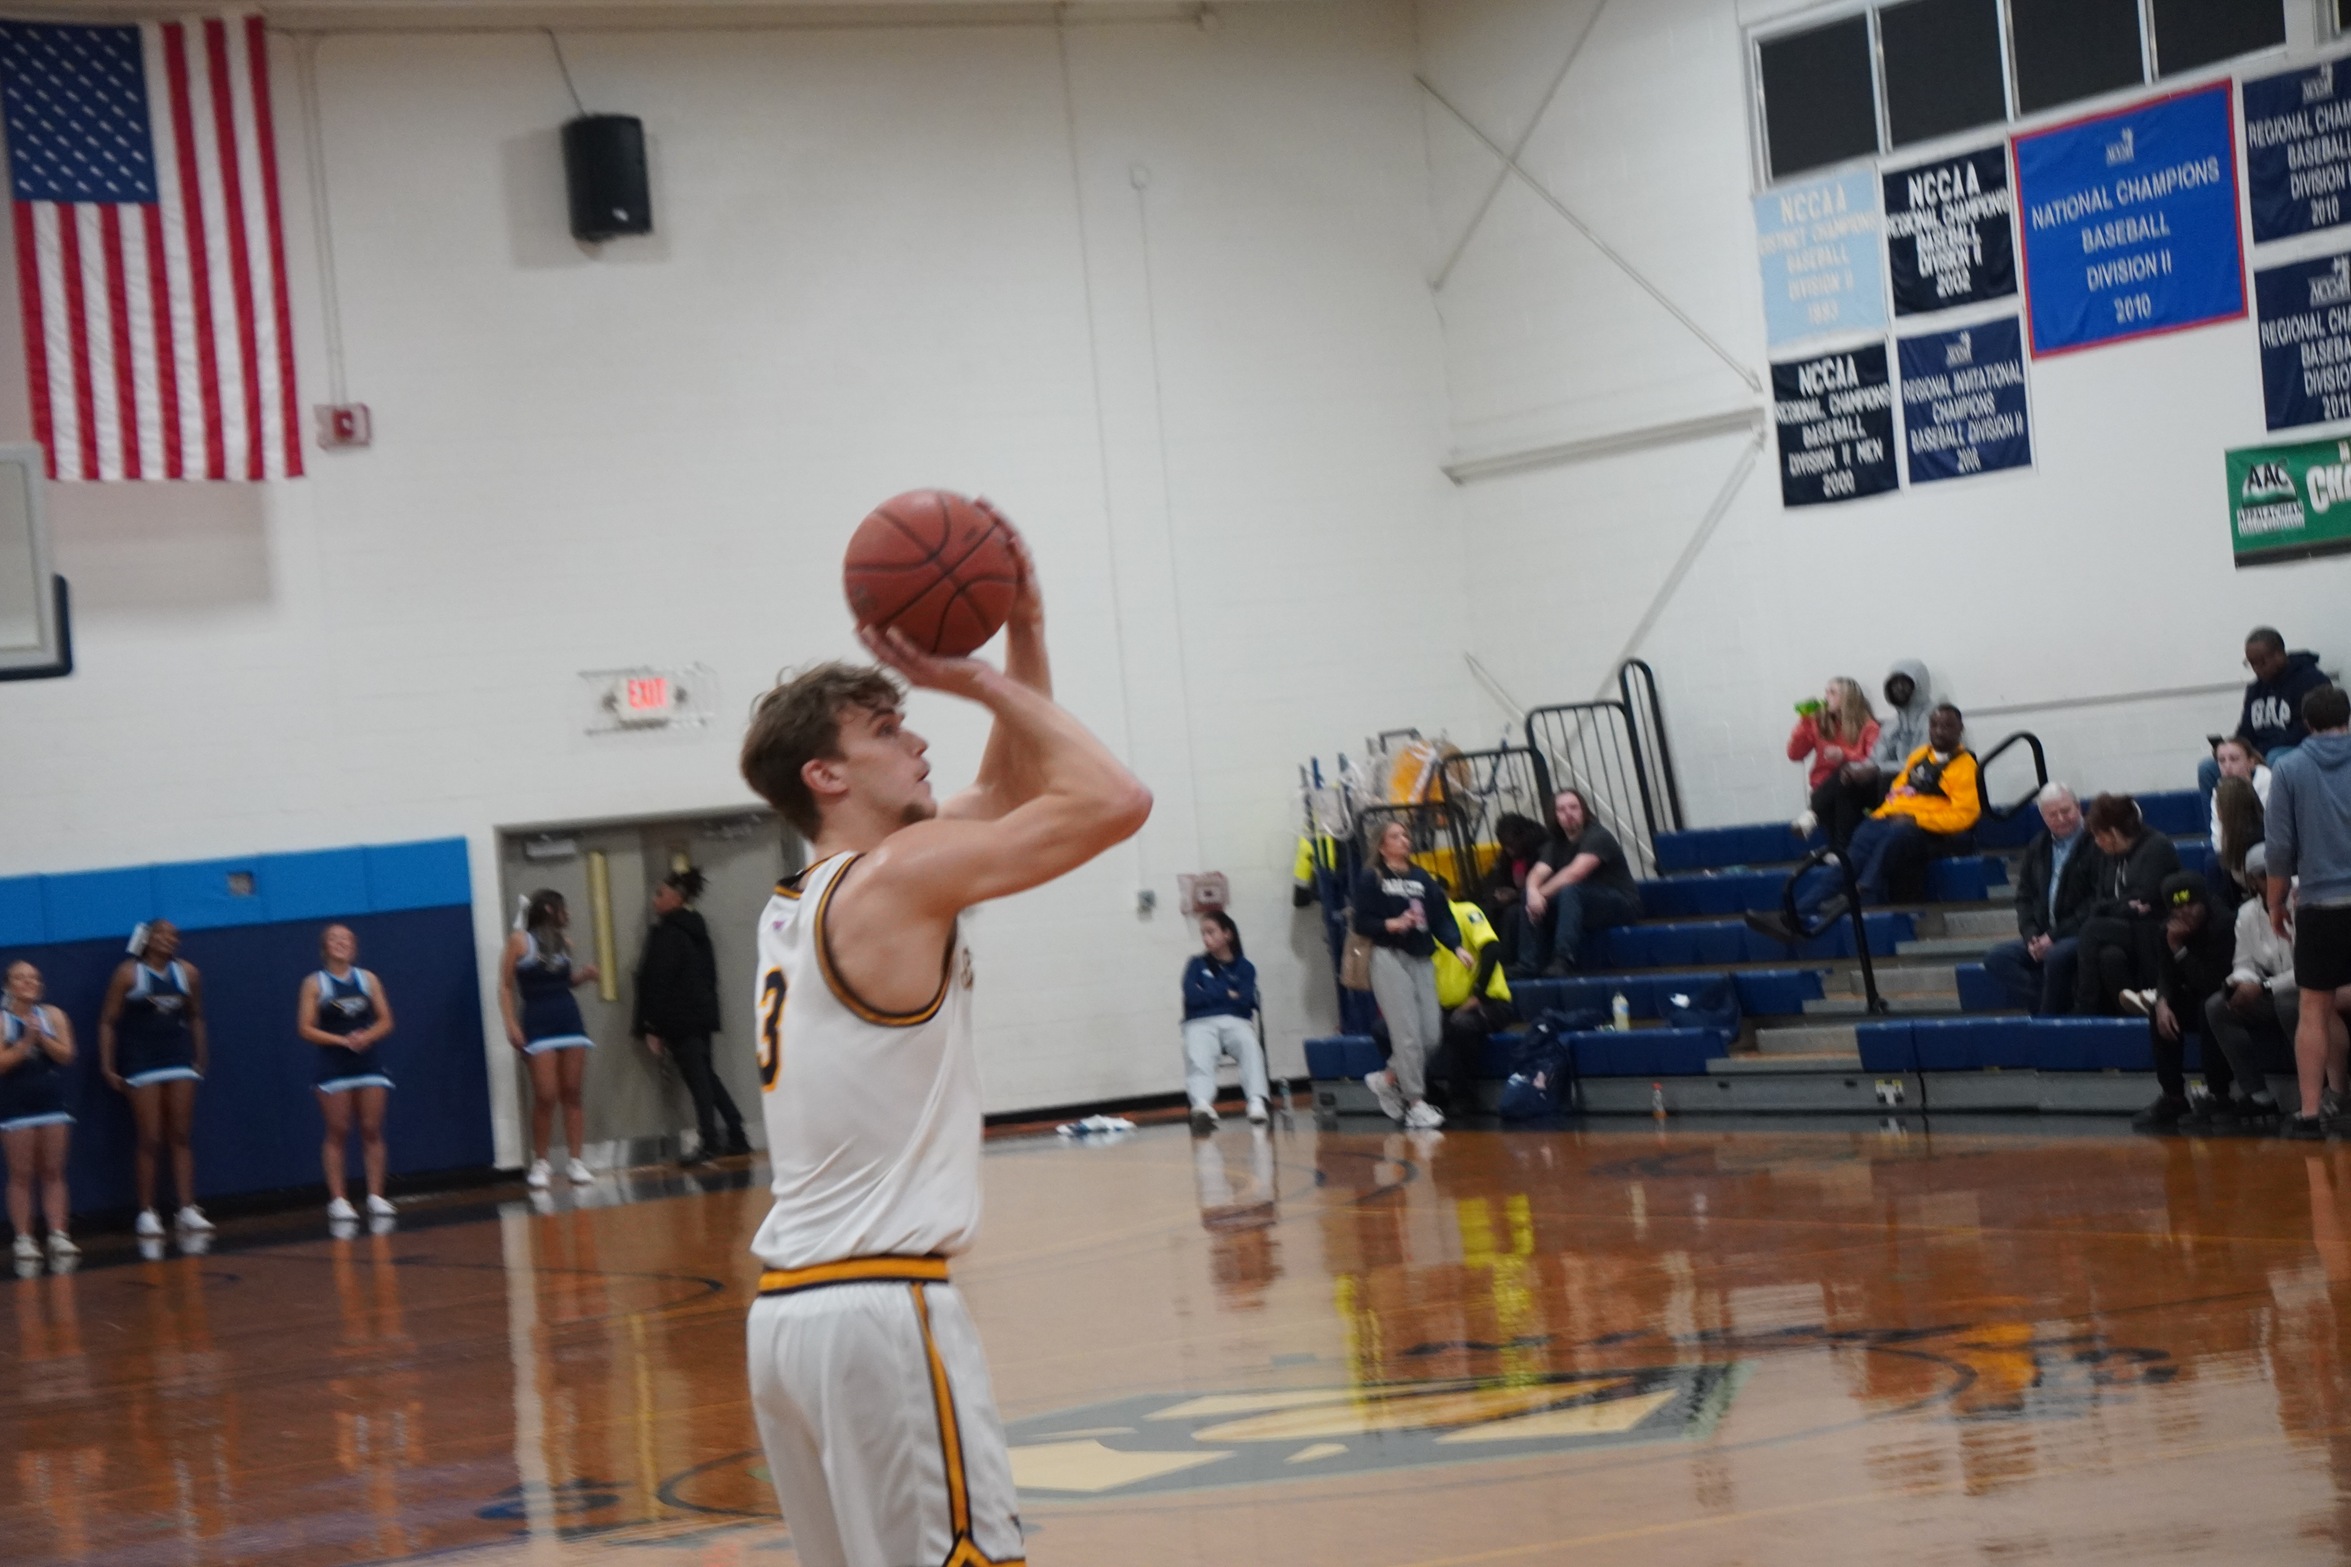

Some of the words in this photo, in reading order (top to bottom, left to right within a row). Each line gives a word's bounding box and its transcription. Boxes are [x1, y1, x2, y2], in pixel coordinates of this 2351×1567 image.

[2247, 110, 2314, 149] REGIONAL
[1907, 160, 1982, 210] NCCAA
[2031, 185, 2113, 231] NATIONAL
[2116, 155, 2220, 206] CHAMPIONS
[2290, 162, 2346, 201] DIVISION
[1780, 181, 1847, 226] NCCAA
[2310, 193, 2340, 226] 2010
[2081, 210, 2171, 254] BASEBALL
[2086, 253, 2158, 293] DIVISION
[2161, 249, 2173, 276] II
[2113, 292, 2152, 325] 2010
[2260, 310, 2327, 350] REGIONAL
[1798, 354, 1860, 397] NCCAA
[2304, 362, 2351, 398] DIVISIO
[1931, 391, 1997, 425] CHAMPIONS
[1802, 414, 1868, 449] BASEBALL
[1910, 423, 1966, 454] BASEBALL
[1967, 414, 2015, 446] DIVISION
[1788, 446, 1837, 478] DIVISION
[2247, 461, 2290, 492] AAC
[628, 677, 668, 710] EXIT
[2250, 695, 2292, 732] GAP
